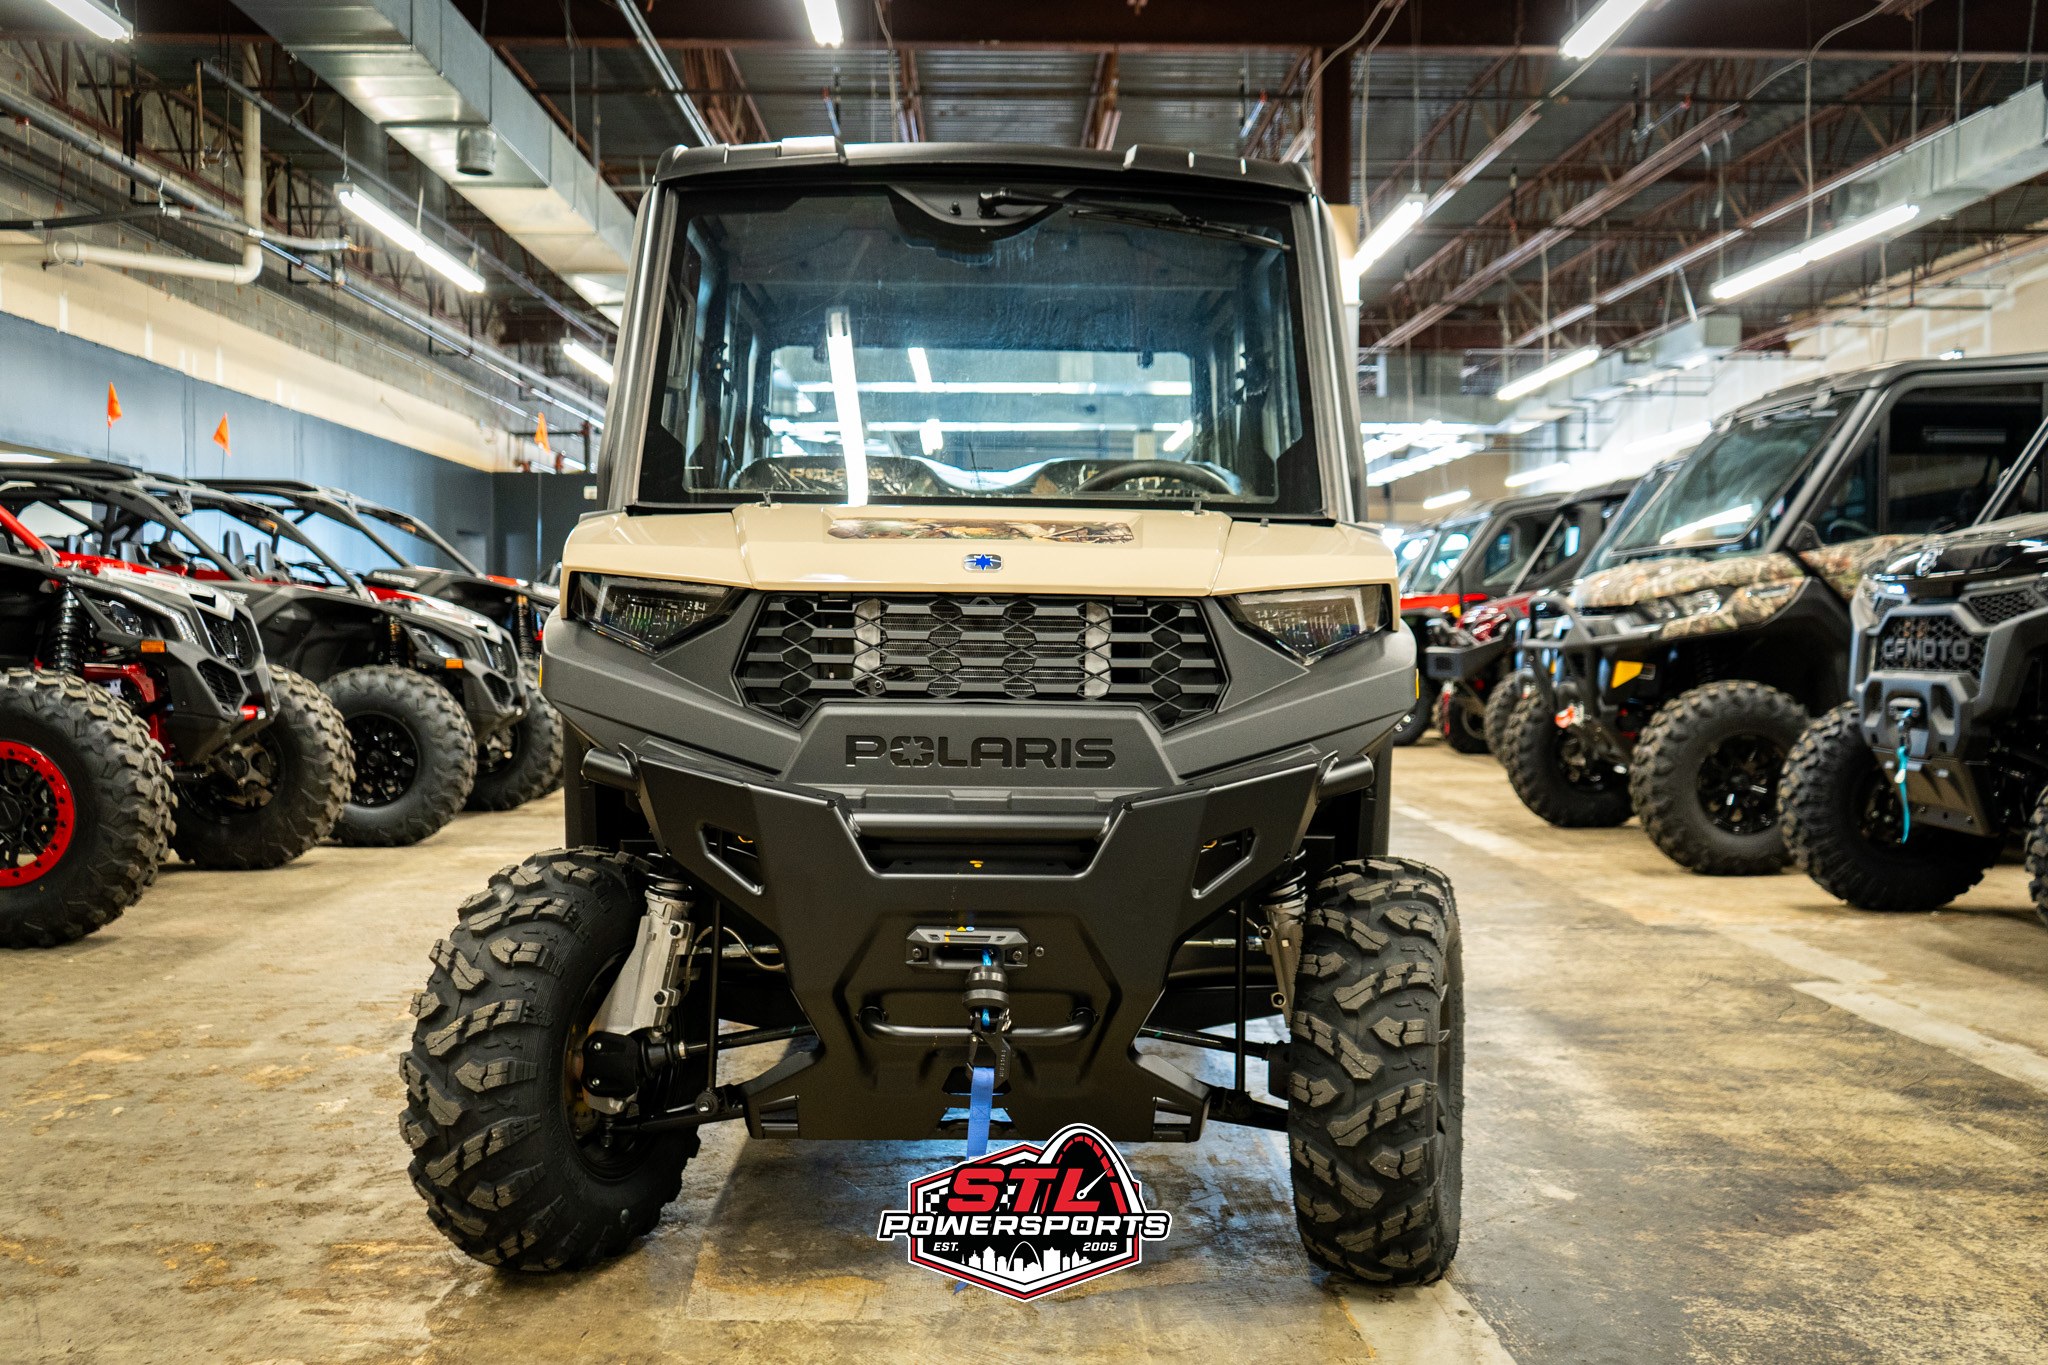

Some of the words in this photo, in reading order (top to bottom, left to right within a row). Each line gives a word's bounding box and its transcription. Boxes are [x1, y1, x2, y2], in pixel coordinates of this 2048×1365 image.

[789, 467, 885, 481] POLAS
[1882, 637, 1971, 662] CFMOTO
[845, 734, 1116, 769] POLARIS
